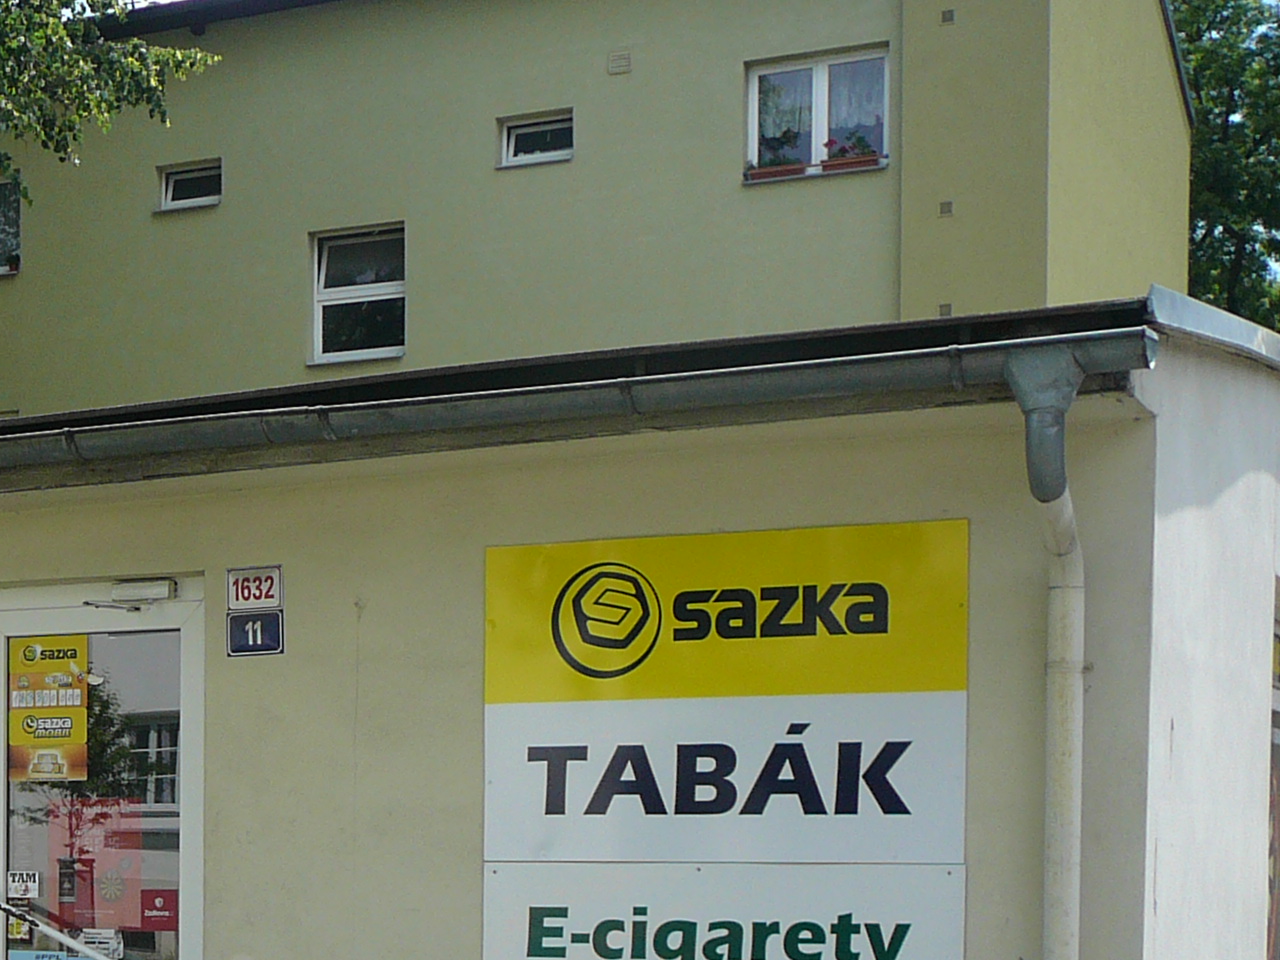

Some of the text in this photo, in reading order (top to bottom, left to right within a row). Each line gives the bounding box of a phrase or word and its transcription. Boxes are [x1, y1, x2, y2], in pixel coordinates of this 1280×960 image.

[232, 575, 275, 602] 1632
[245, 620, 262, 646] 11
[526, 722, 914, 816] TABÁK
[10, 872, 37, 884] TAM
